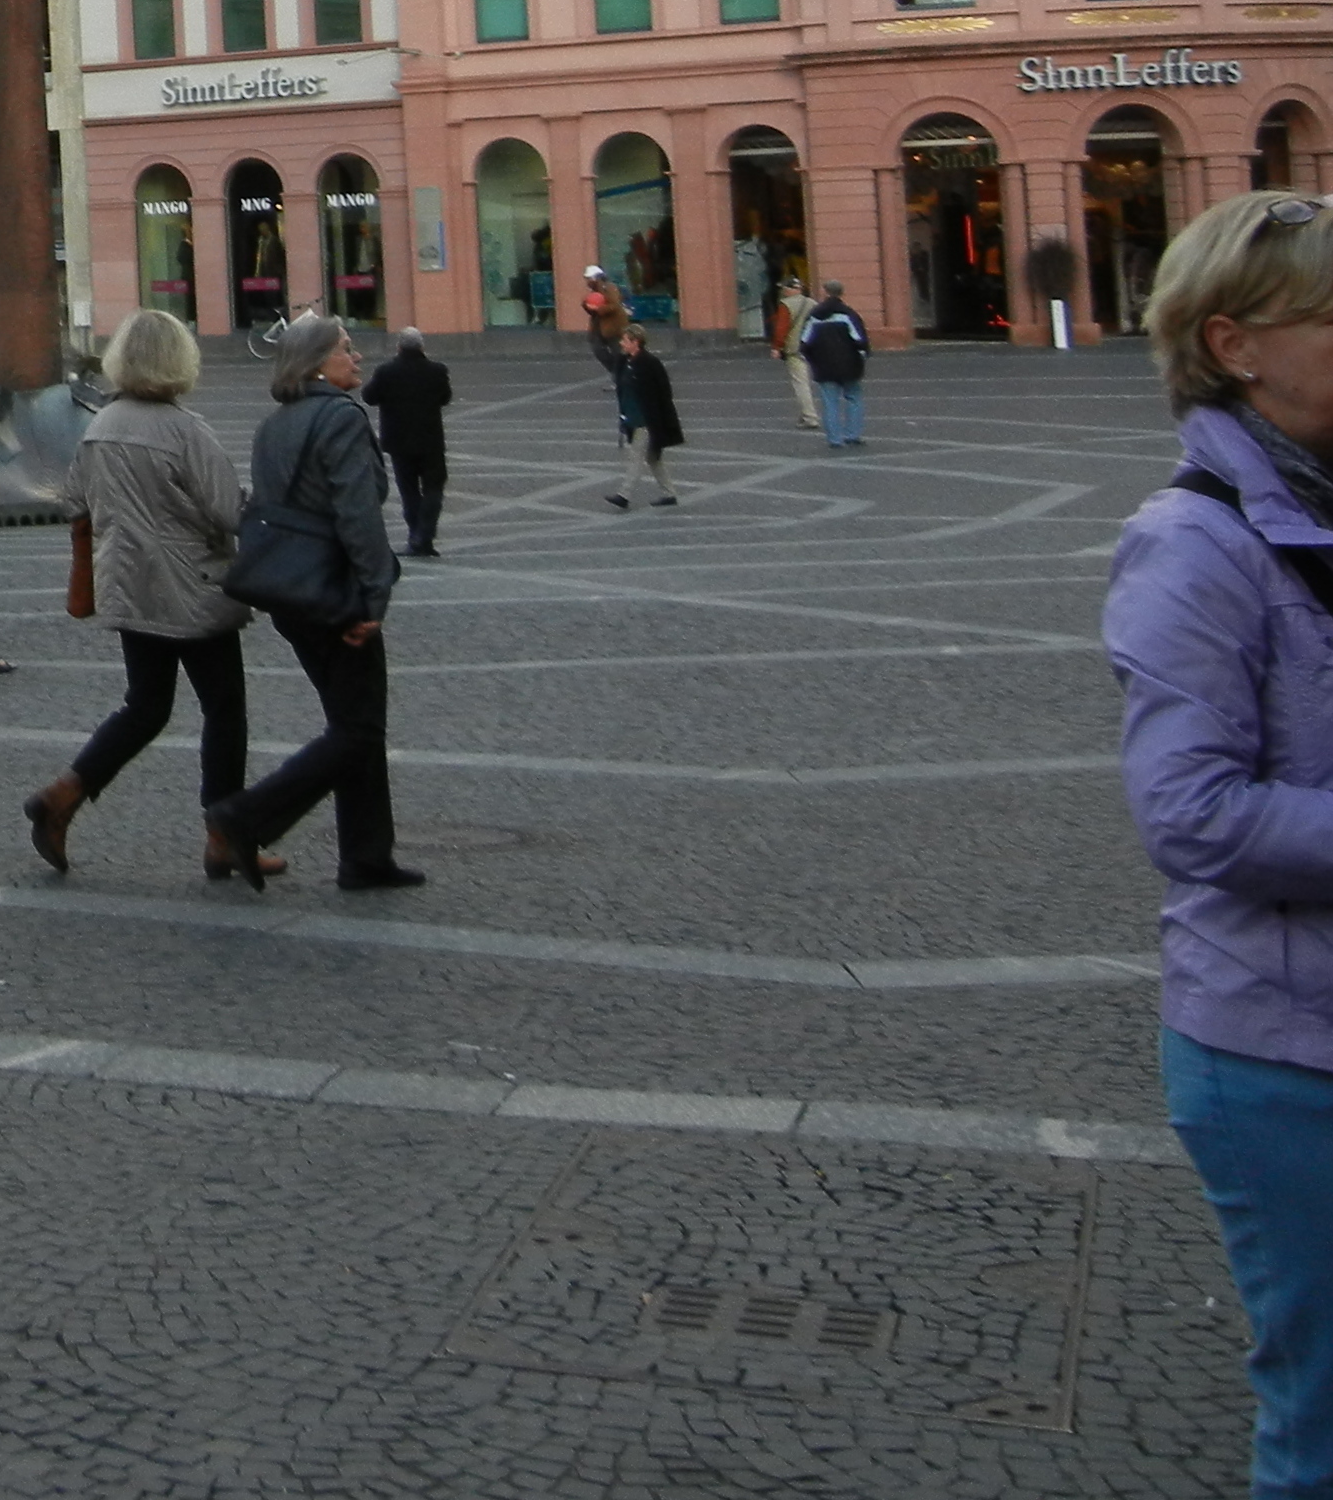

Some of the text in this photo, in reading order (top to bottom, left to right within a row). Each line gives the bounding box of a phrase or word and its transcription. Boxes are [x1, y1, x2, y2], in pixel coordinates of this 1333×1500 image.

[1019, 48, 1242, 92] SinnLeffers
[161, 67, 319, 106] SinnLeffers
[240, 198, 271, 212] MNG
[326, 192, 375, 207] MANGO
[143, 201, 189, 215] MANGO
